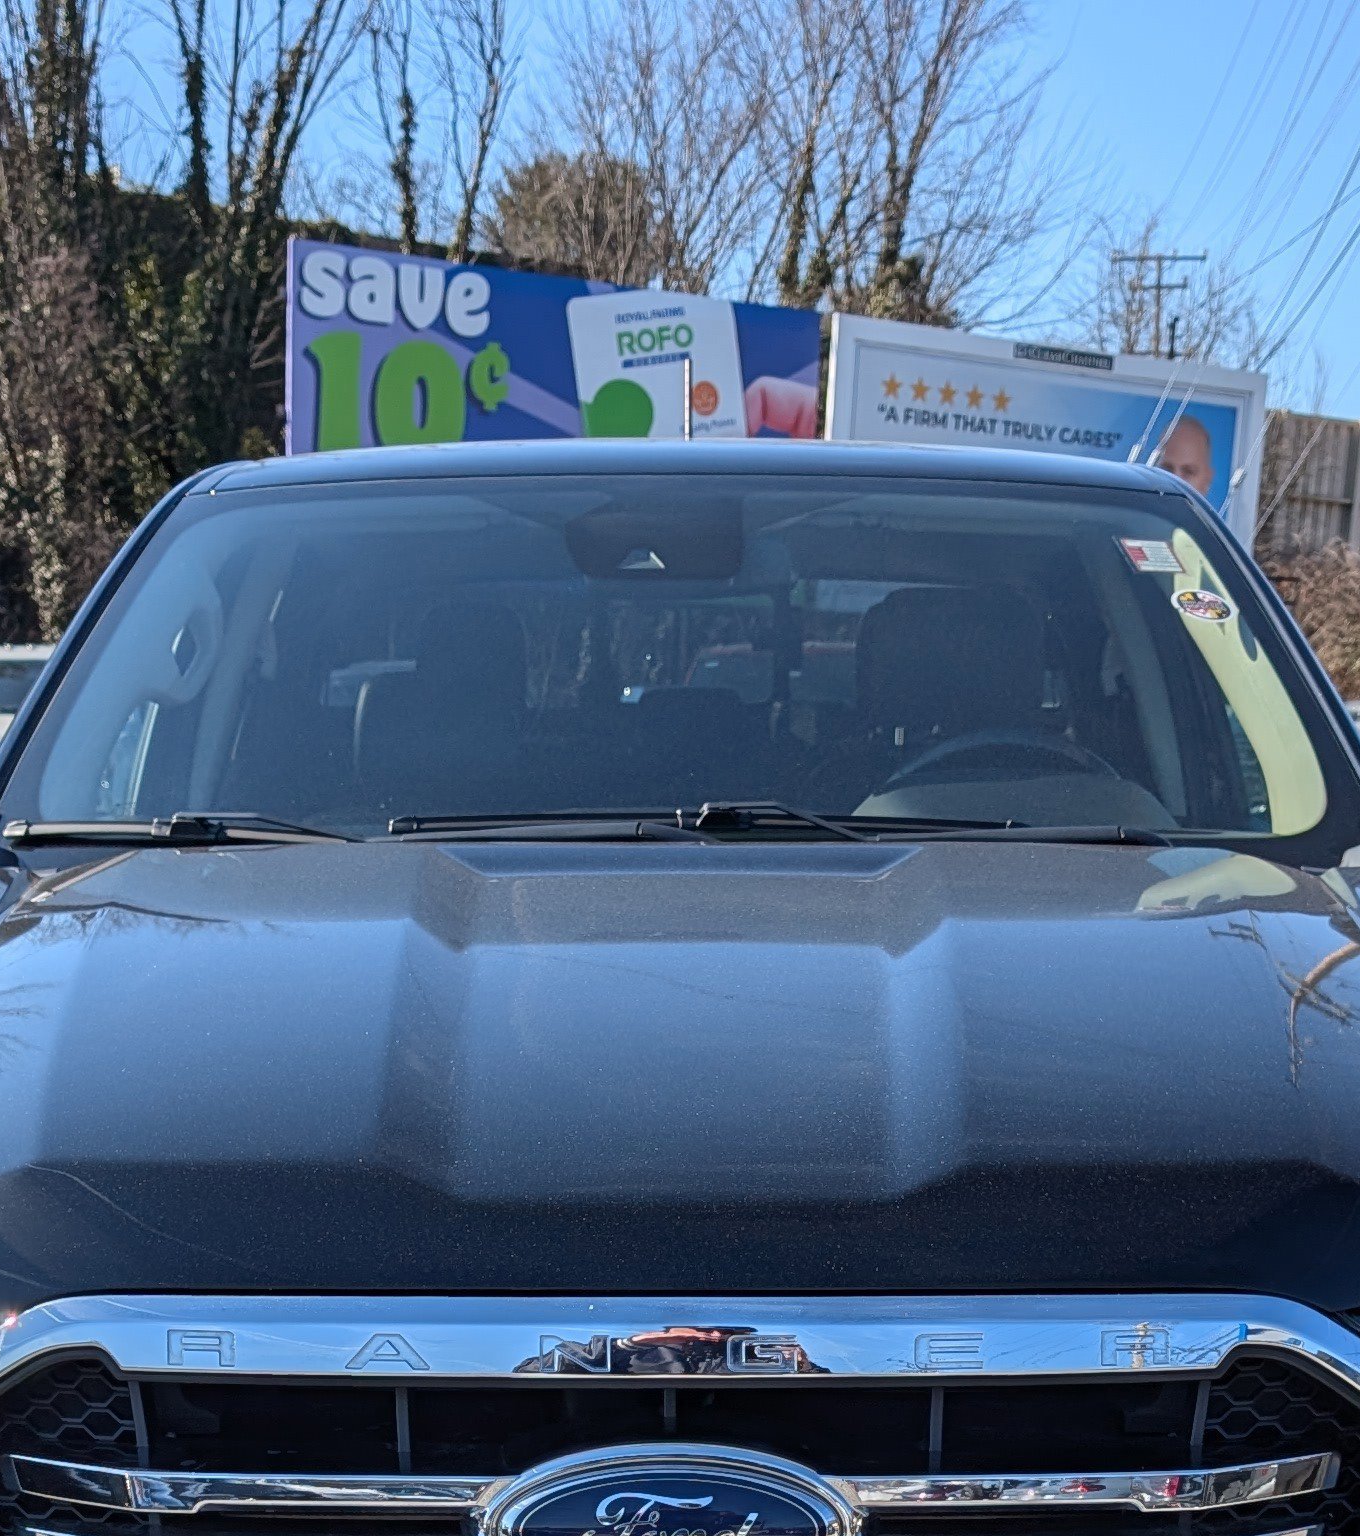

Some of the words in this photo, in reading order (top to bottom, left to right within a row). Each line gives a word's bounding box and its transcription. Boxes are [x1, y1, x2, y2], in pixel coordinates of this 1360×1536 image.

[300, 251, 491, 337] save
[616, 323, 694, 356] ROFO
[903, 407, 949, 429] FIRM
[953, 413, 998, 435] THAT
[1002, 419, 1057, 442] TRULY
[167, 1328, 1171, 1374] RANGER
